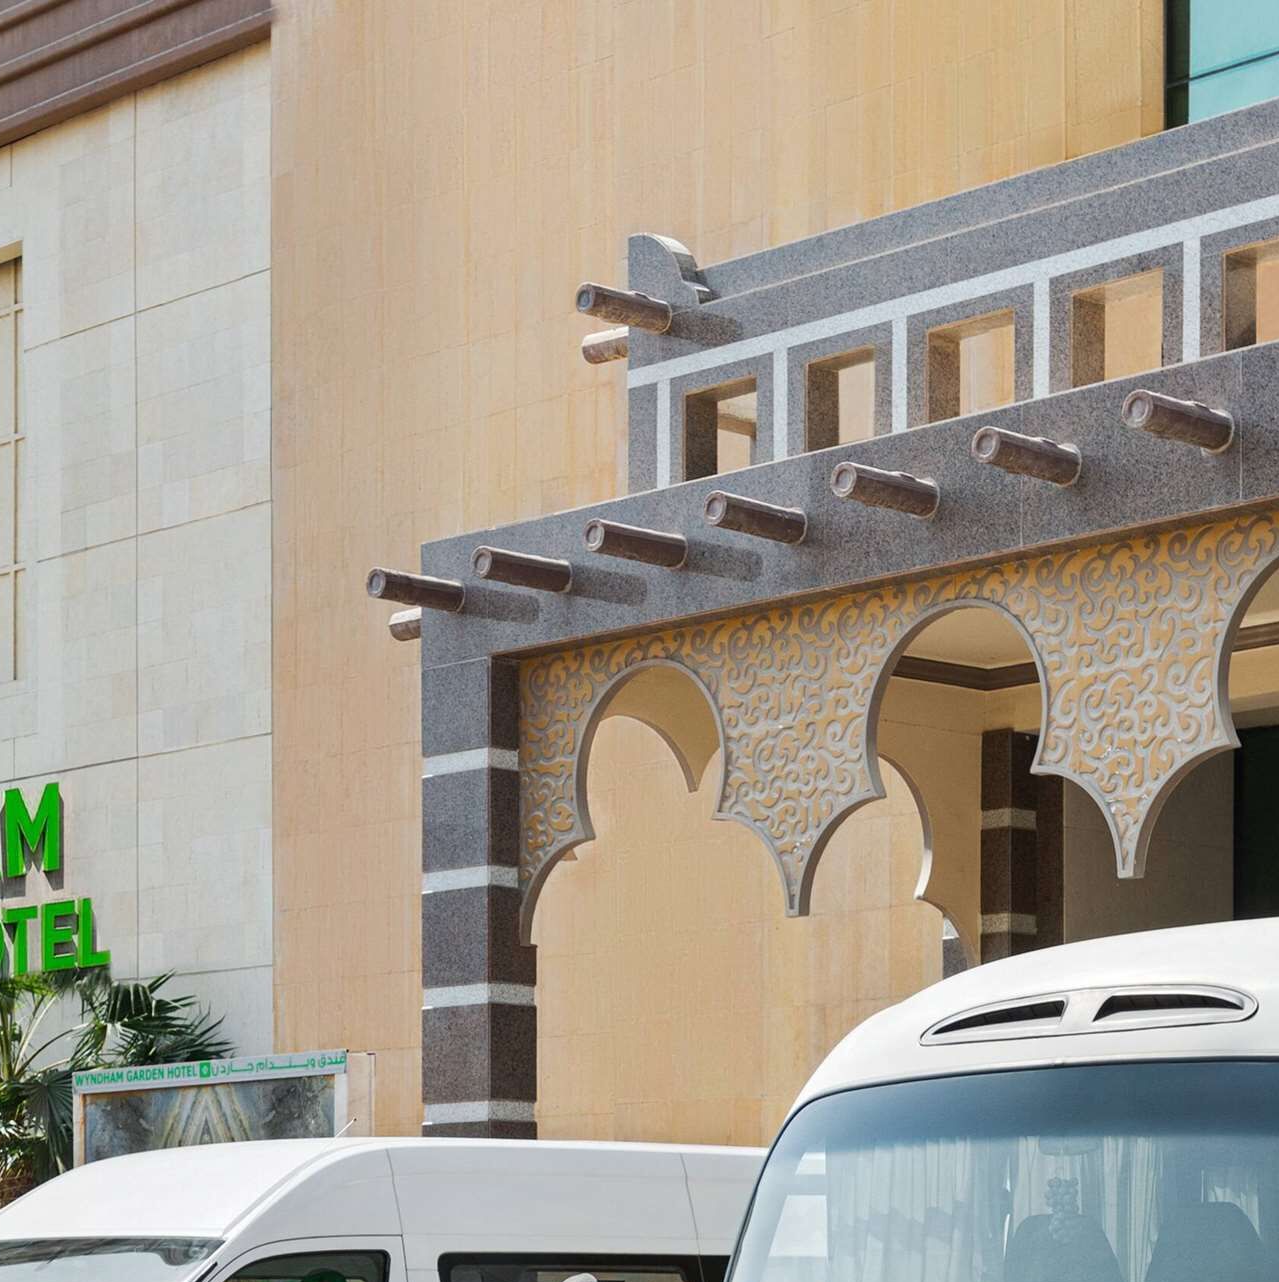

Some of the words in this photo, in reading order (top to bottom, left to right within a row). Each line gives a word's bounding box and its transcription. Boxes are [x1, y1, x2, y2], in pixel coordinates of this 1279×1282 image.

[75, 1071, 124, 1087] WYNDHAM
[127, 1068, 164, 1083] GARDEN
[167, 1066, 198, 1079] HOTEL
